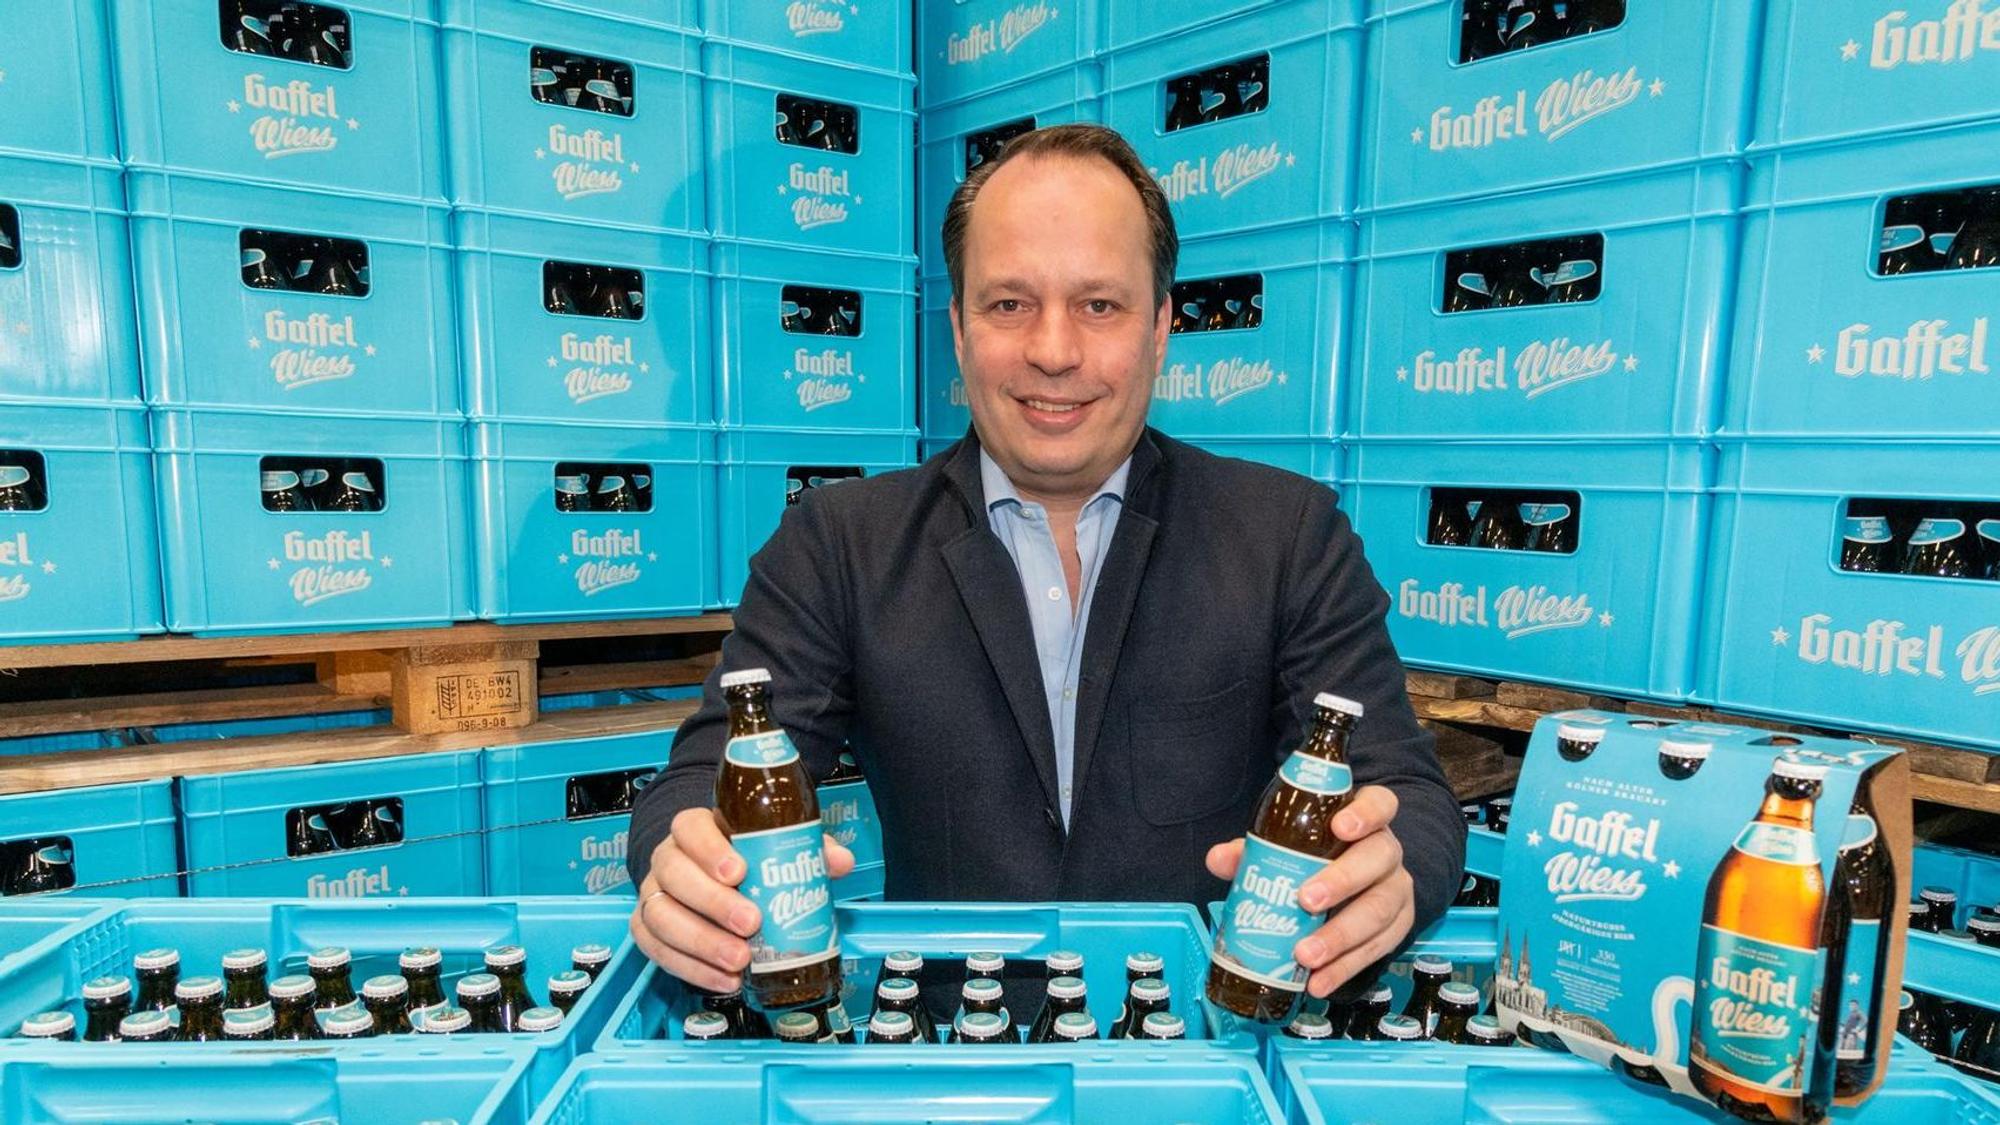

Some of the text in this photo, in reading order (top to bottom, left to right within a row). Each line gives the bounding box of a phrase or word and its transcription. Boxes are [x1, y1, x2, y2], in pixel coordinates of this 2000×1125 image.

[785, 0, 843, 37] Wiess
[948, 0, 1049, 64] Gaffel Wiess
[244, 73, 340, 122] Gaffel
[1429, 66, 1643, 152] Gaffel Wiess
[249, 114, 339, 159] Wiess
[549, 124, 624, 166] Gaffel
[552, 158, 624, 200] Wiess
[789, 163, 850, 198] Gaffel
[1211, 141, 1283, 198] Wiess
[791, 192, 849, 230] Wiess
[264, 308, 358, 349] Gaffel
[561, 333, 634, 367] Gaffel
[1835, 317, 1989, 381] Gaffel
[270, 345, 355, 391] Wiess
[563, 365, 632, 404] Wiess
[795, 348, 853, 378] Gaffel
[1154, 357, 1274, 405] affel Wiess
[1414, 337, 1618, 399] Gaffel Wiess
[797, 376, 853, 411] Wiess
[284, 530, 373, 564] Gaffel
[572, 529, 642, 558] Gaffel
[287, 562, 372, 607] Wiess
[573, 555, 642, 596] Wiess
[1399, 579, 1594, 639] Gaffel Wiess
[1799, 613, 1945, 679] Gaffel
[1547, 799, 1662, 865] Gaffel
[307, 864, 392, 898] Gaffel
[760, 848, 827, 888] Gaffel
[1544, 849, 1649, 903] Wiess
[1234, 898, 1301, 937] Wiess
[1710, 955, 1797, 1012] Gaffel
[1710, 995, 1792, 1039] Wiess
